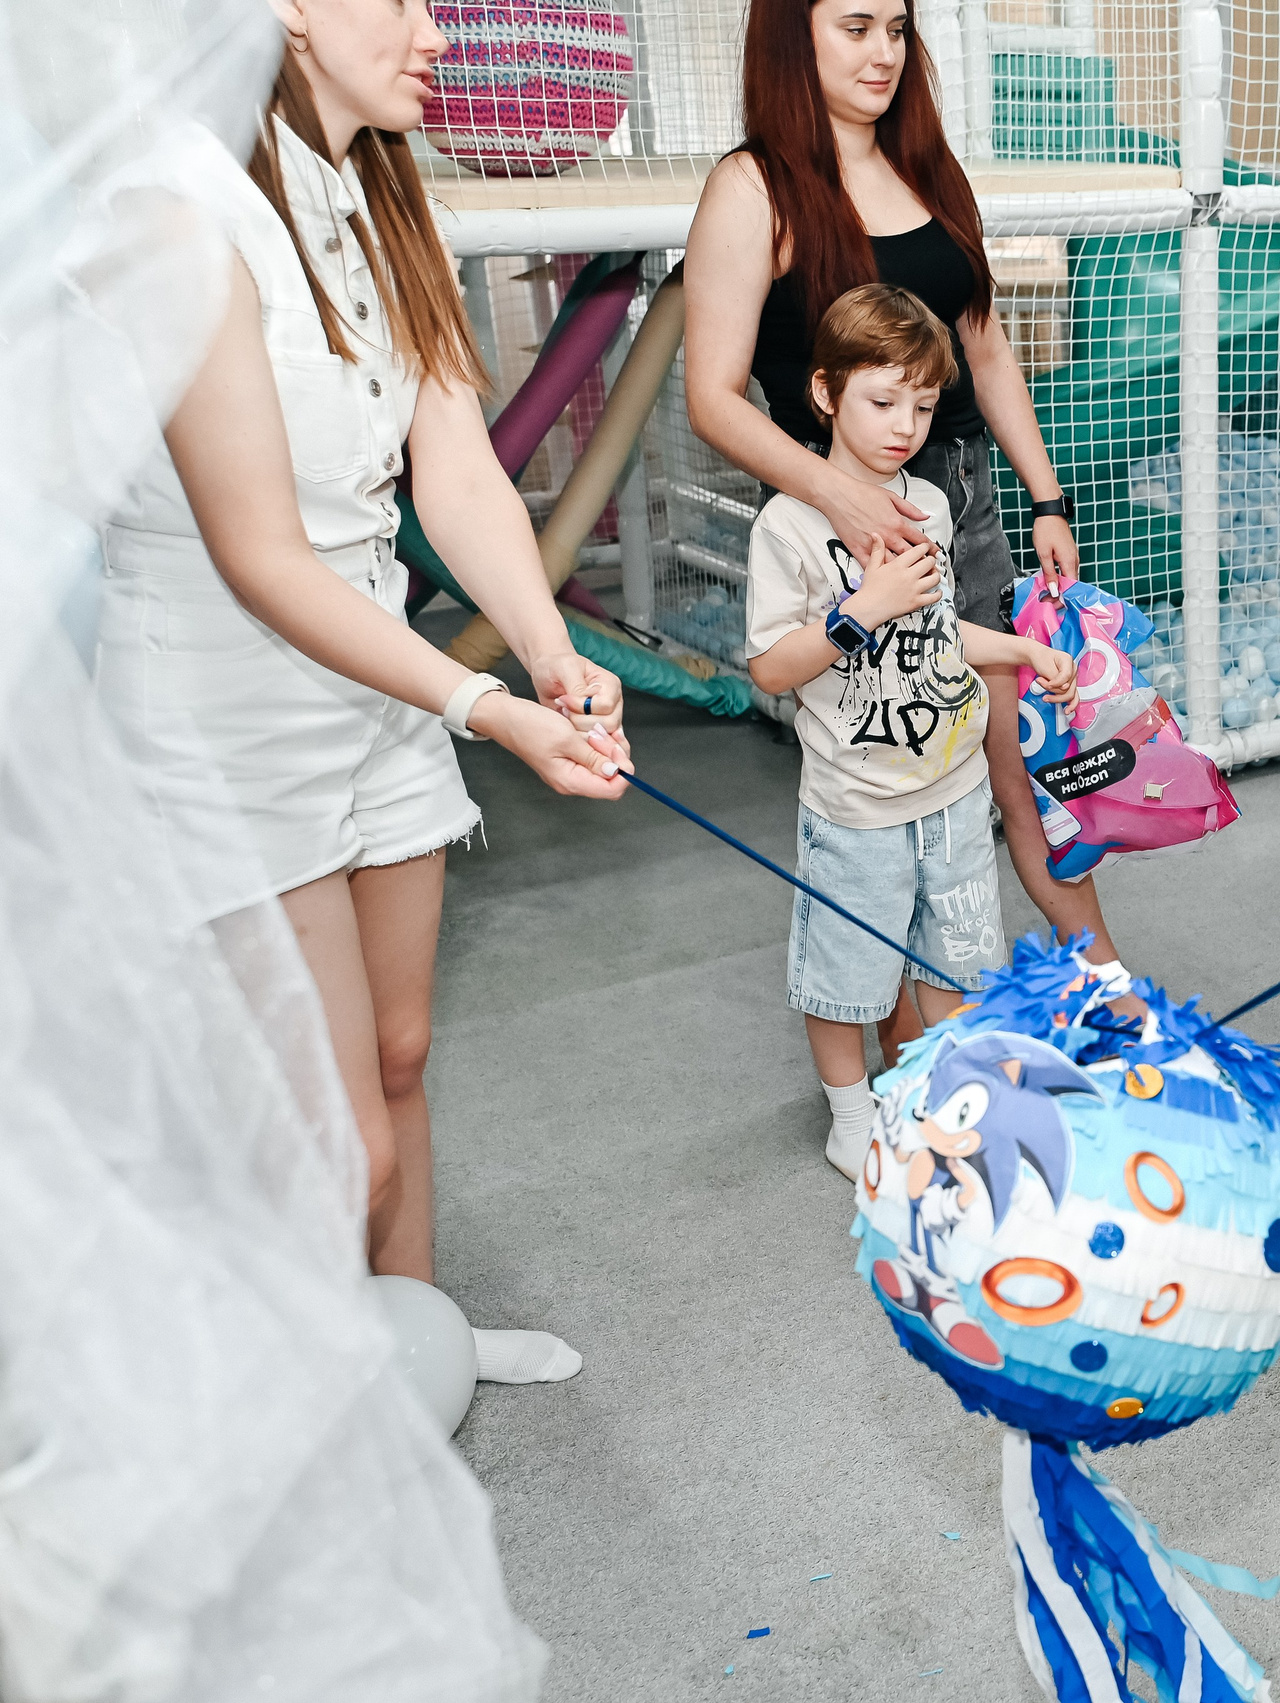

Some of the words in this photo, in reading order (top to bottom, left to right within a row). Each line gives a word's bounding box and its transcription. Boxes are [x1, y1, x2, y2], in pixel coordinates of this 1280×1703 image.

[850, 699, 939, 756] UP
[1045, 767, 1070, 783] вся
[942, 925, 998, 962] BO
